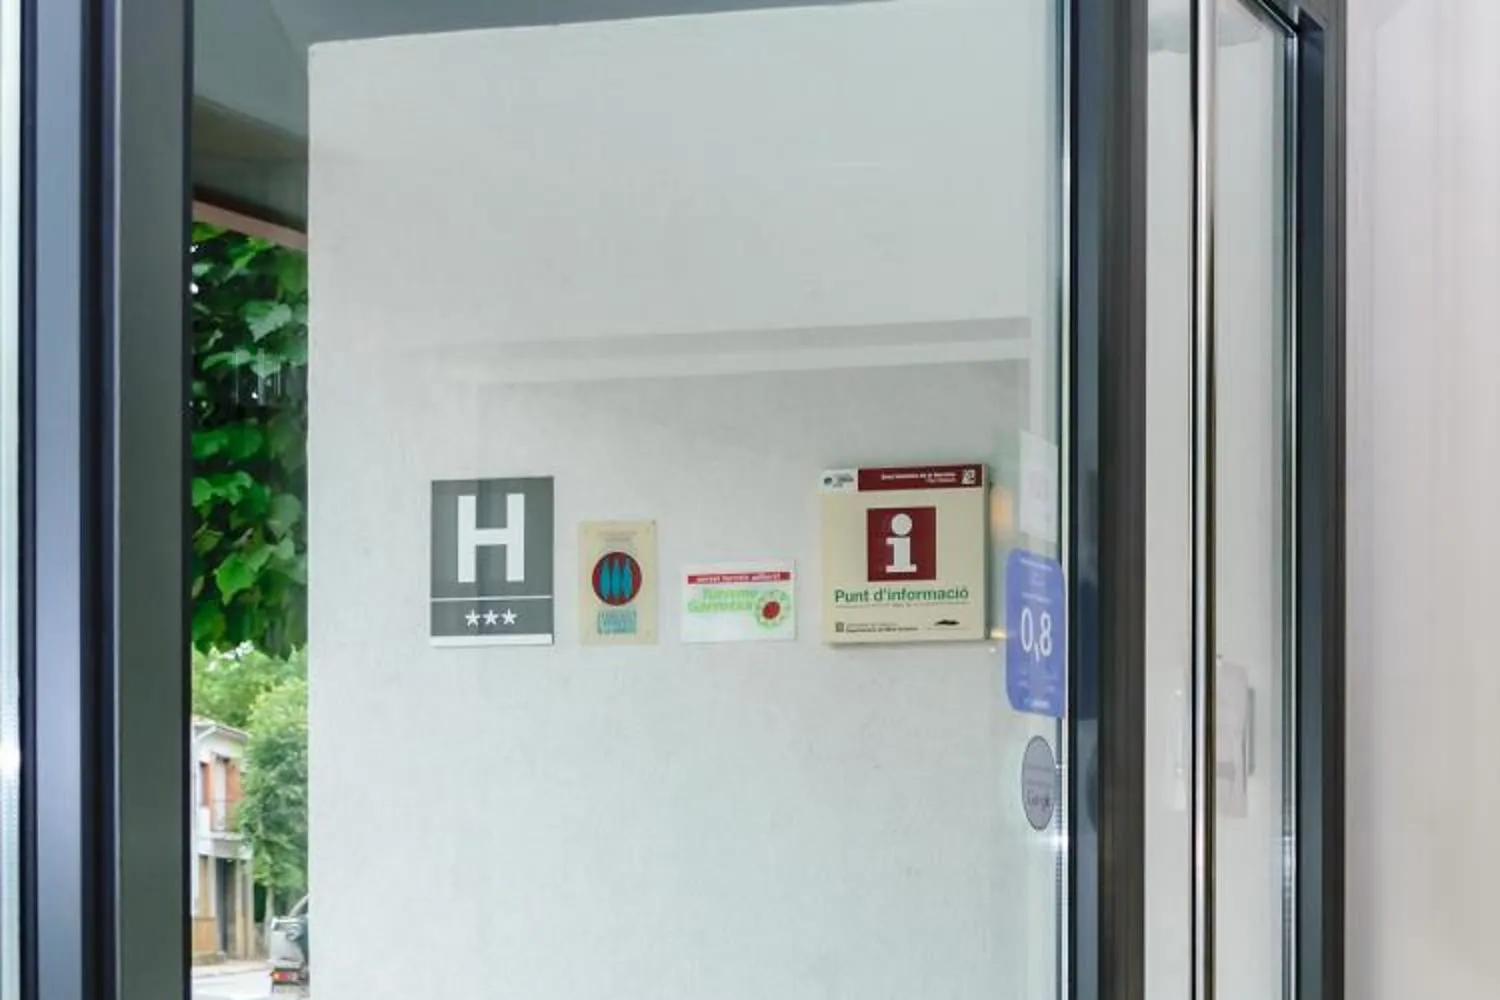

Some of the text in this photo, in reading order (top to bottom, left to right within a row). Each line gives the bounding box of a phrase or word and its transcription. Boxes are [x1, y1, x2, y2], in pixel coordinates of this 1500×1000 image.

[457, 492, 525, 583] H
[834, 585, 969, 603] Punt d'informació
